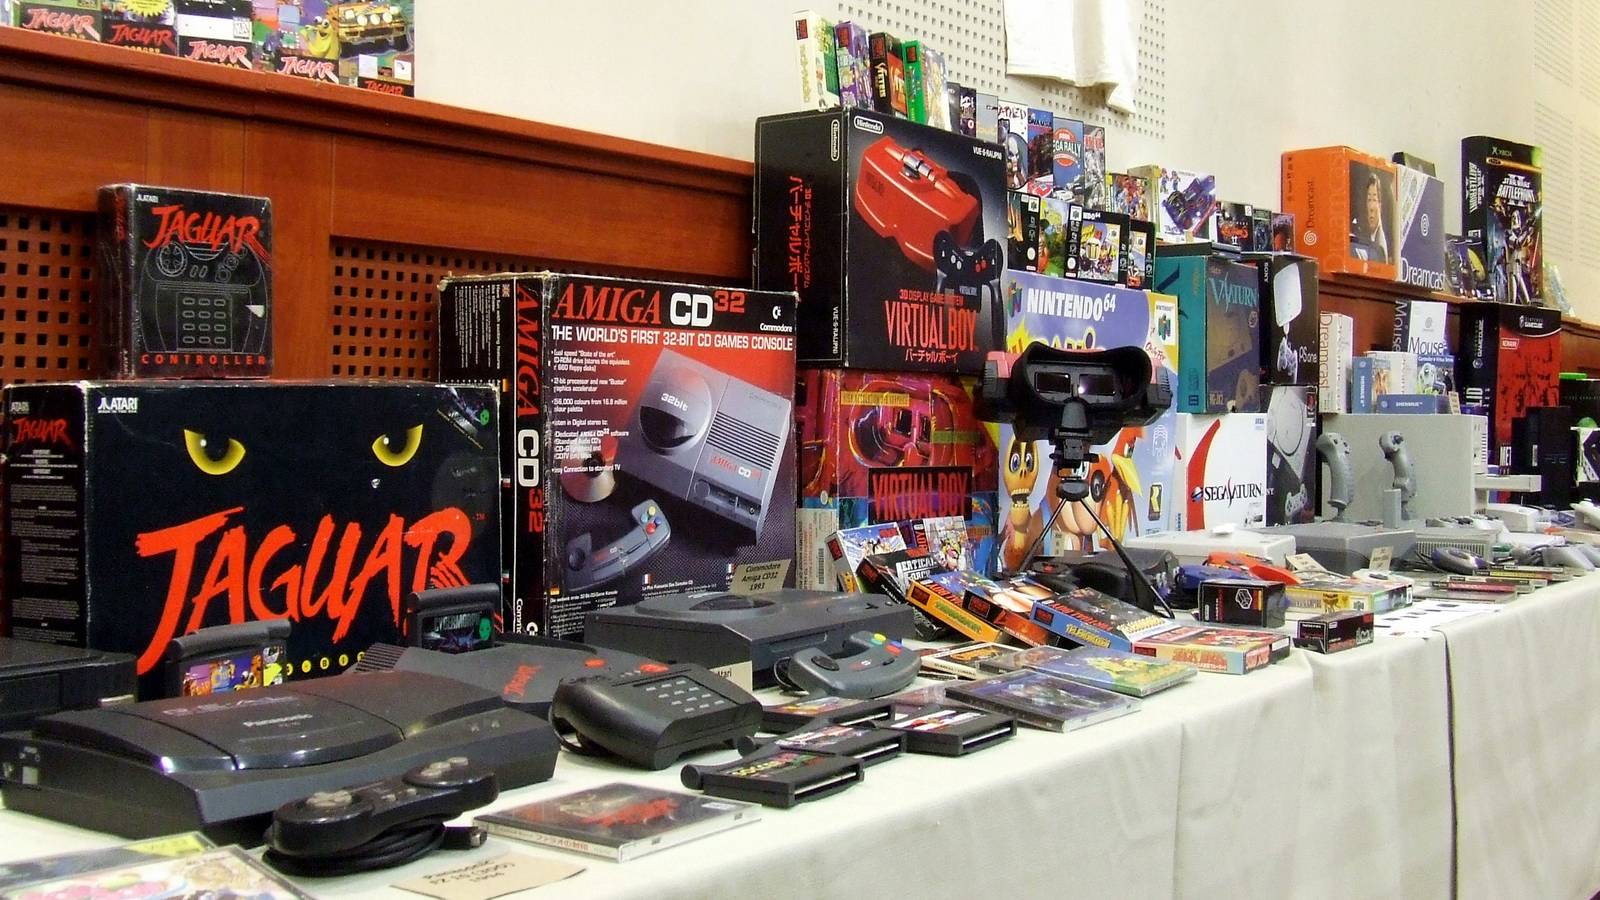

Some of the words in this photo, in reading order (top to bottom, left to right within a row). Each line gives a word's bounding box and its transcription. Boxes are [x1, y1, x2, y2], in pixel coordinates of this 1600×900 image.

[23, 8, 100, 41] JAGUAR
[109, 24, 177, 49] JAGUAR
[185, 40, 252, 68] JAGUAR
[277, 56, 339, 84] JAGUAR
[857, 120, 881, 131] Nintendo
[143, 204, 272, 264] JAGUAR
[788, 176, 803, 293] バーチャルボー
[1401, 258, 1447, 290] Dreamcast
[552, 282, 662, 325] AMIGA
[908, 290, 929, 301] DISPLAY
[1027, 288, 1103, 321] NINTENDO
[552, 325, 573, 341] THE
[576, 327, 628, 343] WORLD'S
[631, 329, 660, 345] FIRST
[663, 332, 695, 347] 32-BIT
[698, 333, 712, 347] CD
[714, 334, 749, 349] GAMES
[751, 336, 793, 351] CONSOLE
[760, 322, 793, 333] Commodore
[885, 300, 947, 350] VIRTUAL
[948, 307, 977, 352] BOY
[1392, 299, 1407, 352] Mouse
[141, 354, 266, 366] CONTROLLER
[517, 286, 540, 417] AMIGA
[905, 349, 958, 363] バーチャルボーイ
[1319, 314, 1333, 389] Dreamcast
[1409, 337, 1443, 356] Mouse
[11, 402, 29, 411] ATARI
[111, 397, 138, 410] ATARI
[661, 393, 688, 411] 32bit
[15, 418, 72, 444] JAGUAR
[518, 429, 540, 487] CD
[872, 472, 933, 519] VIRTUAL
[938, 472, 968, 518] BOY
[137, 507, 472, 675] JAGUAR
